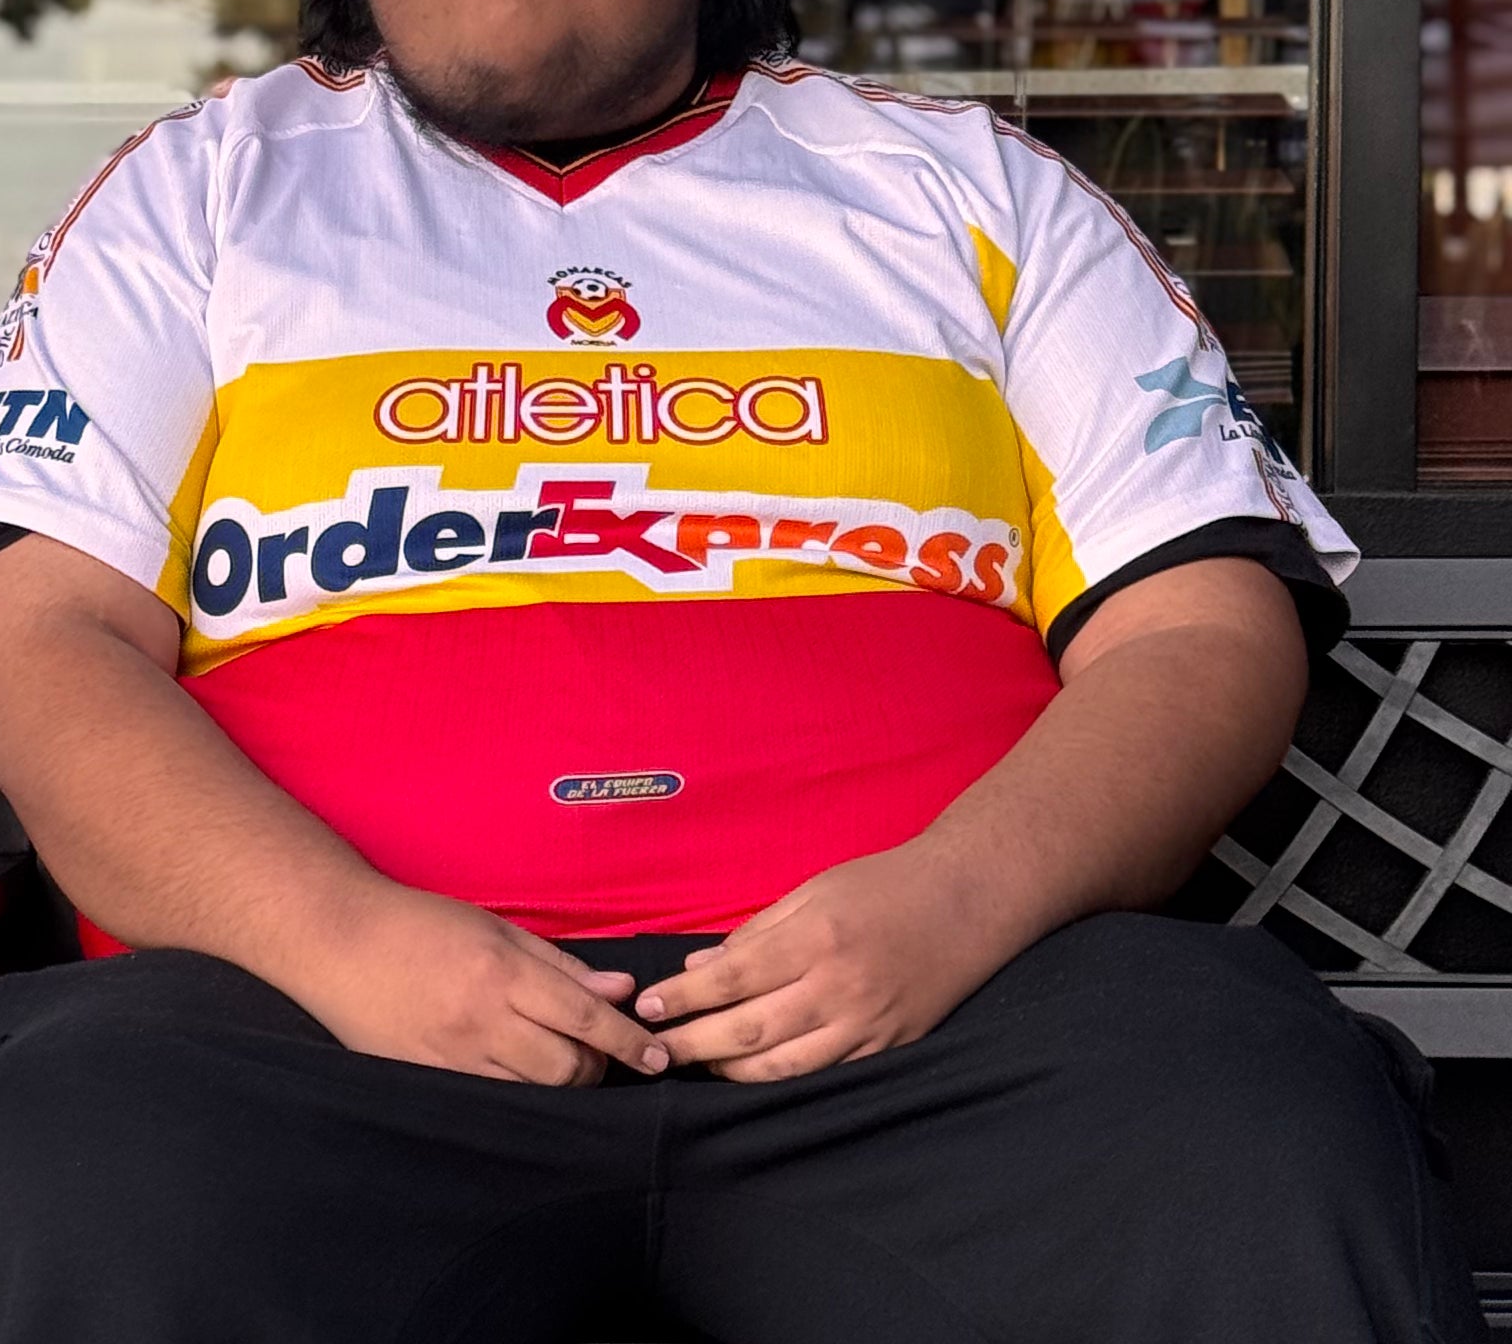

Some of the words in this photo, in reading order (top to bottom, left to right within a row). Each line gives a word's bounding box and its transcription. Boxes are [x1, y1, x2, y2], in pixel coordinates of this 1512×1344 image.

[547, 266, 632, 288] MONARCAS
[374, 362, 829, 446] atletica
[5, 437, 76, 464] Cómoda
[567, 789, 585, 799] DE
[591, 787, 609, 797] LA
[613, 784, 668, 797] FUERZA
[581, 780, 597, 791] EL
